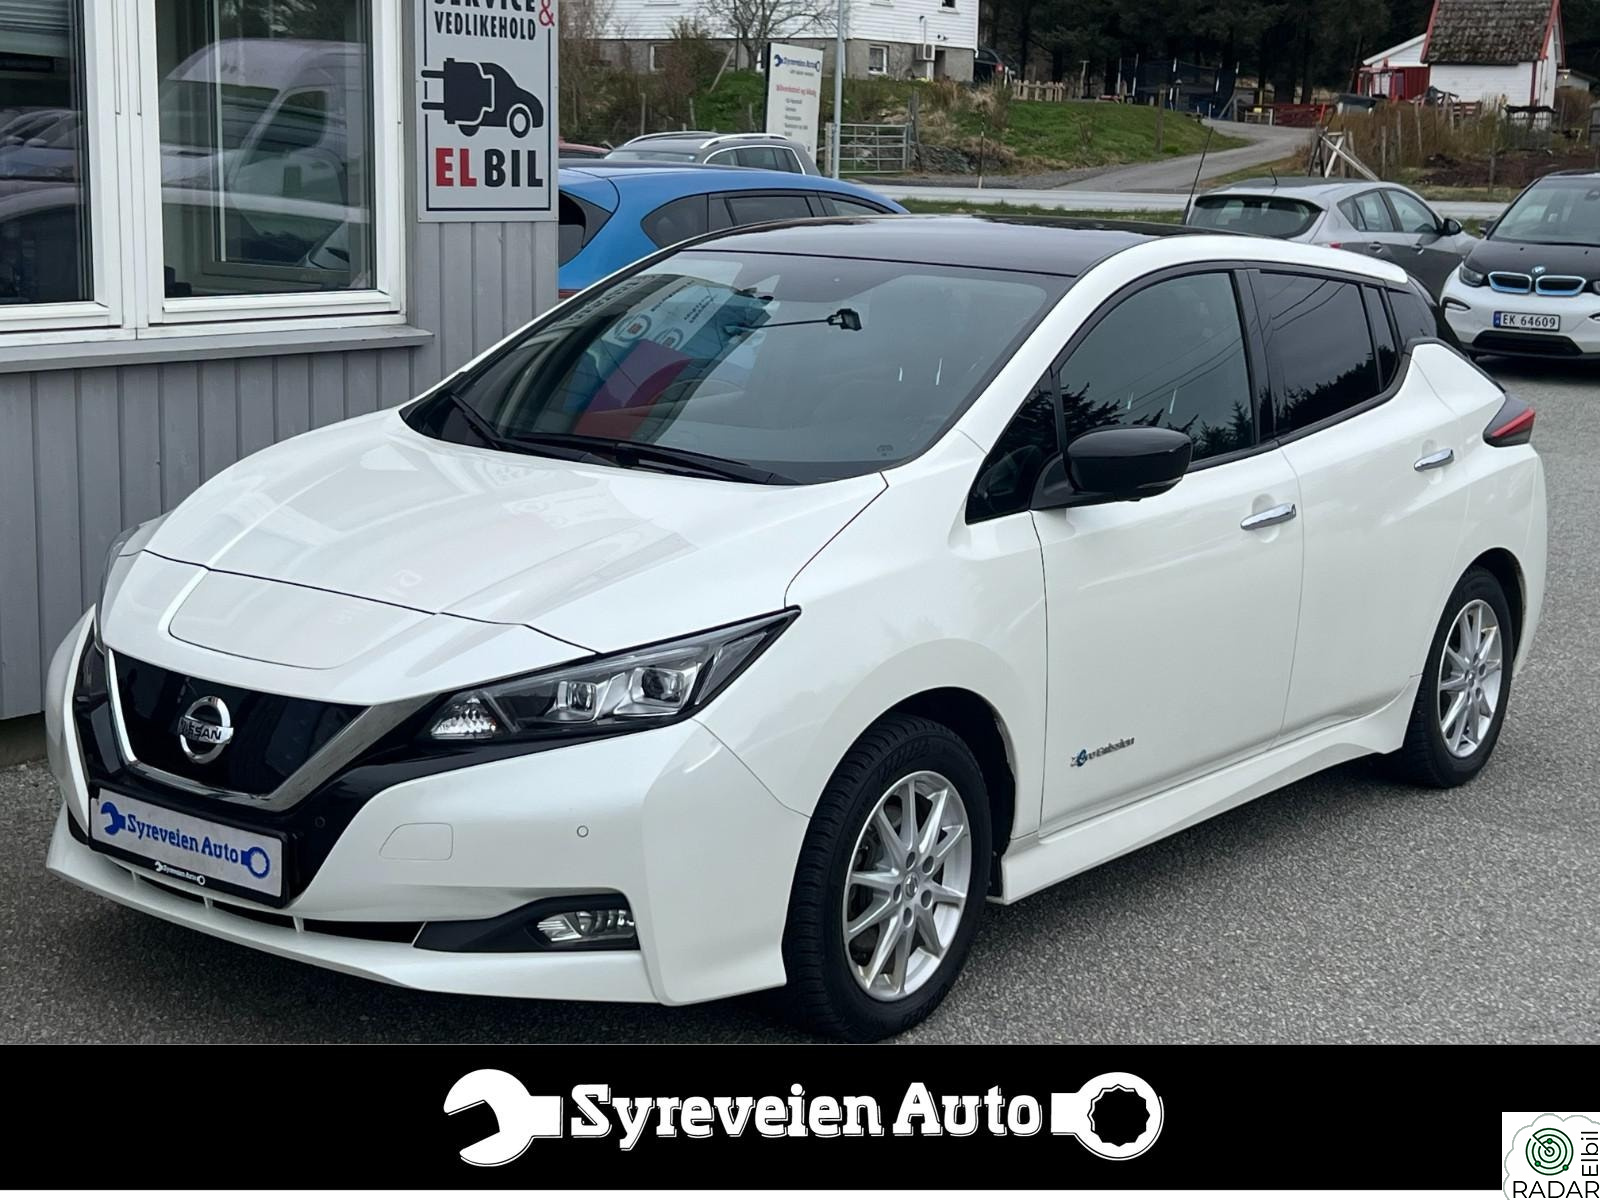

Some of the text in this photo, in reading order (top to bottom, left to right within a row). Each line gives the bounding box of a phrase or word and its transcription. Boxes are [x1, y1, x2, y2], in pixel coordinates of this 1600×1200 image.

[434, 11, 536, 41] VEDLIKEHOLD
[436, 148, 543, 188] ELBIL
[1503, 314, 1516, 325] EK
[1520, 316, 1556, 328] 64609
[180, 718, 222, 740] NISSAN
[127, 813, 239, 864] Syreveien Auto
